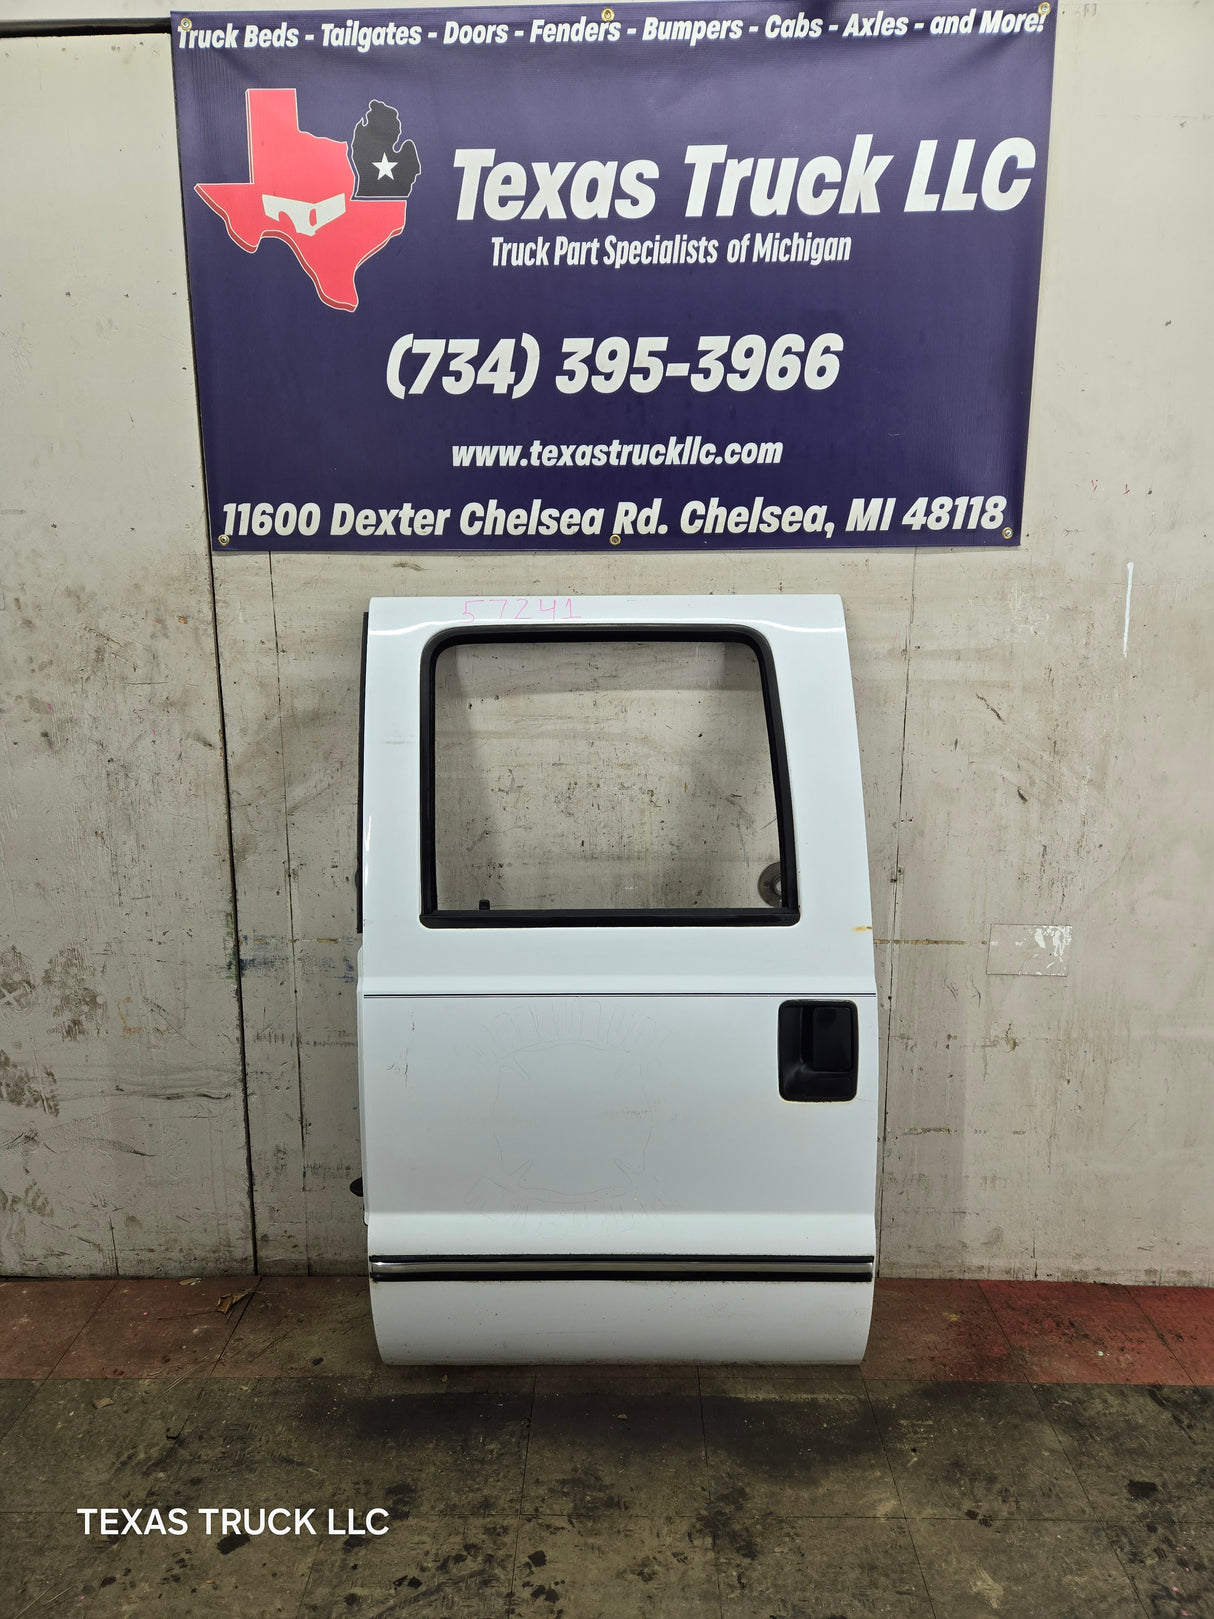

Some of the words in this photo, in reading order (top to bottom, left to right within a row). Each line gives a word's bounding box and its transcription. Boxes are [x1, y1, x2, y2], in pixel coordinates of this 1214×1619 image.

[177, 23, 240, 49] Truck
[243, 22, 300, 48] Beds
[321, 20, 423, 53] Tailgates
[443, 21, 510, 46] Doors
[529, 19, 622, 44] Fenders
[642, 16, 744, 49] Bumpers
[765, 12, 824, 40] Cabs
[842, 10, 909, 38] Axles
[930, 8, 977, 35] and
[979, 10, 1047, 34] More!
[453, 148, 660, 222] Texas
[684, 134, 894, 217] Truck
[904, 136, 1037, 213] LLC
[492, 236, 551, 267] Truck
[553, 236, 601, 266] Part
[603, 233, 720, 269] Specialists
[727, 233, 751, 264] of
[752, 232, 852, 266] Michigan
[386, 333, 541, 400] (734)
[555, 332, 845, 394] 395-3966
[452, 436, 785, 467] www.texastruckllc.com
[222, 502, 321, 536] 11600
[330, 502, 452, 536] Dexter
[459, 498, 605, 536] Chelsea
[613, 498, 668, 535] Rd.
[680, 497, 835, 539] Chelsea,
[845, 497, 896, 532] MI
[901, 495, 1008, 531] 48118
[460, 598, 582, 623] 57241
